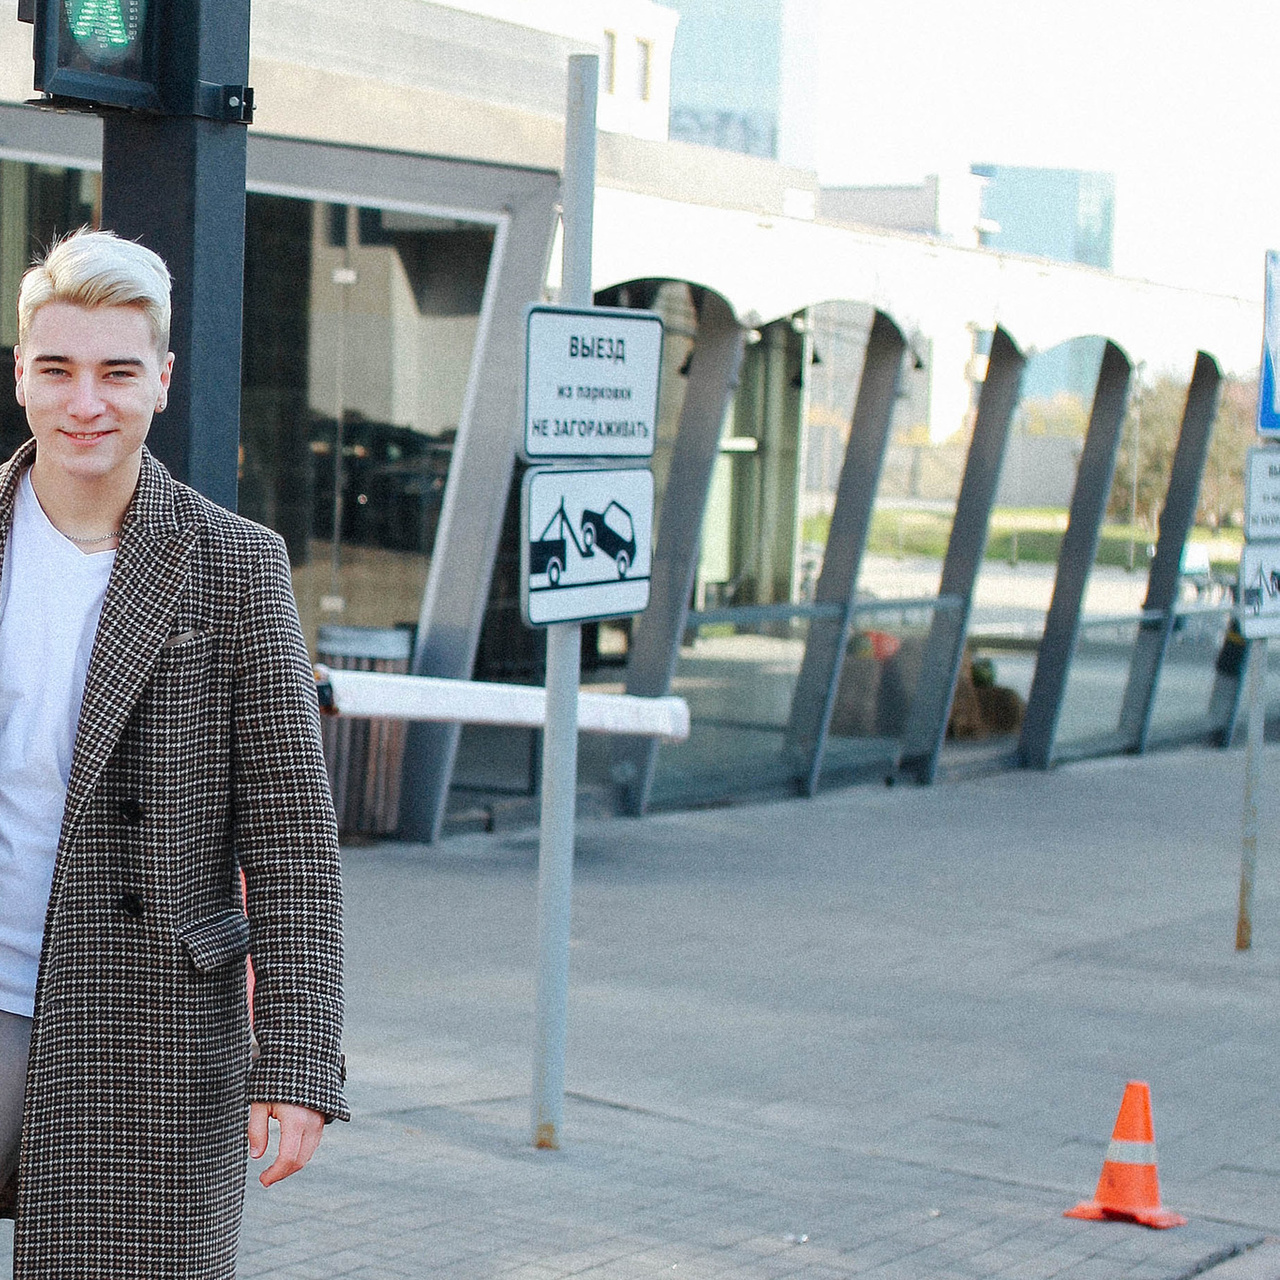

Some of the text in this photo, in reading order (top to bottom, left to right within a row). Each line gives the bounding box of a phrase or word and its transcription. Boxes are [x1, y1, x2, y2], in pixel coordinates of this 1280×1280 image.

[570, 336, 624, 363] ВЫЕЗД
[577, 386, 631, 402] парковки
[532, 419, 648, 437] НЕ ЗАГОРАЖИВАТЬ
